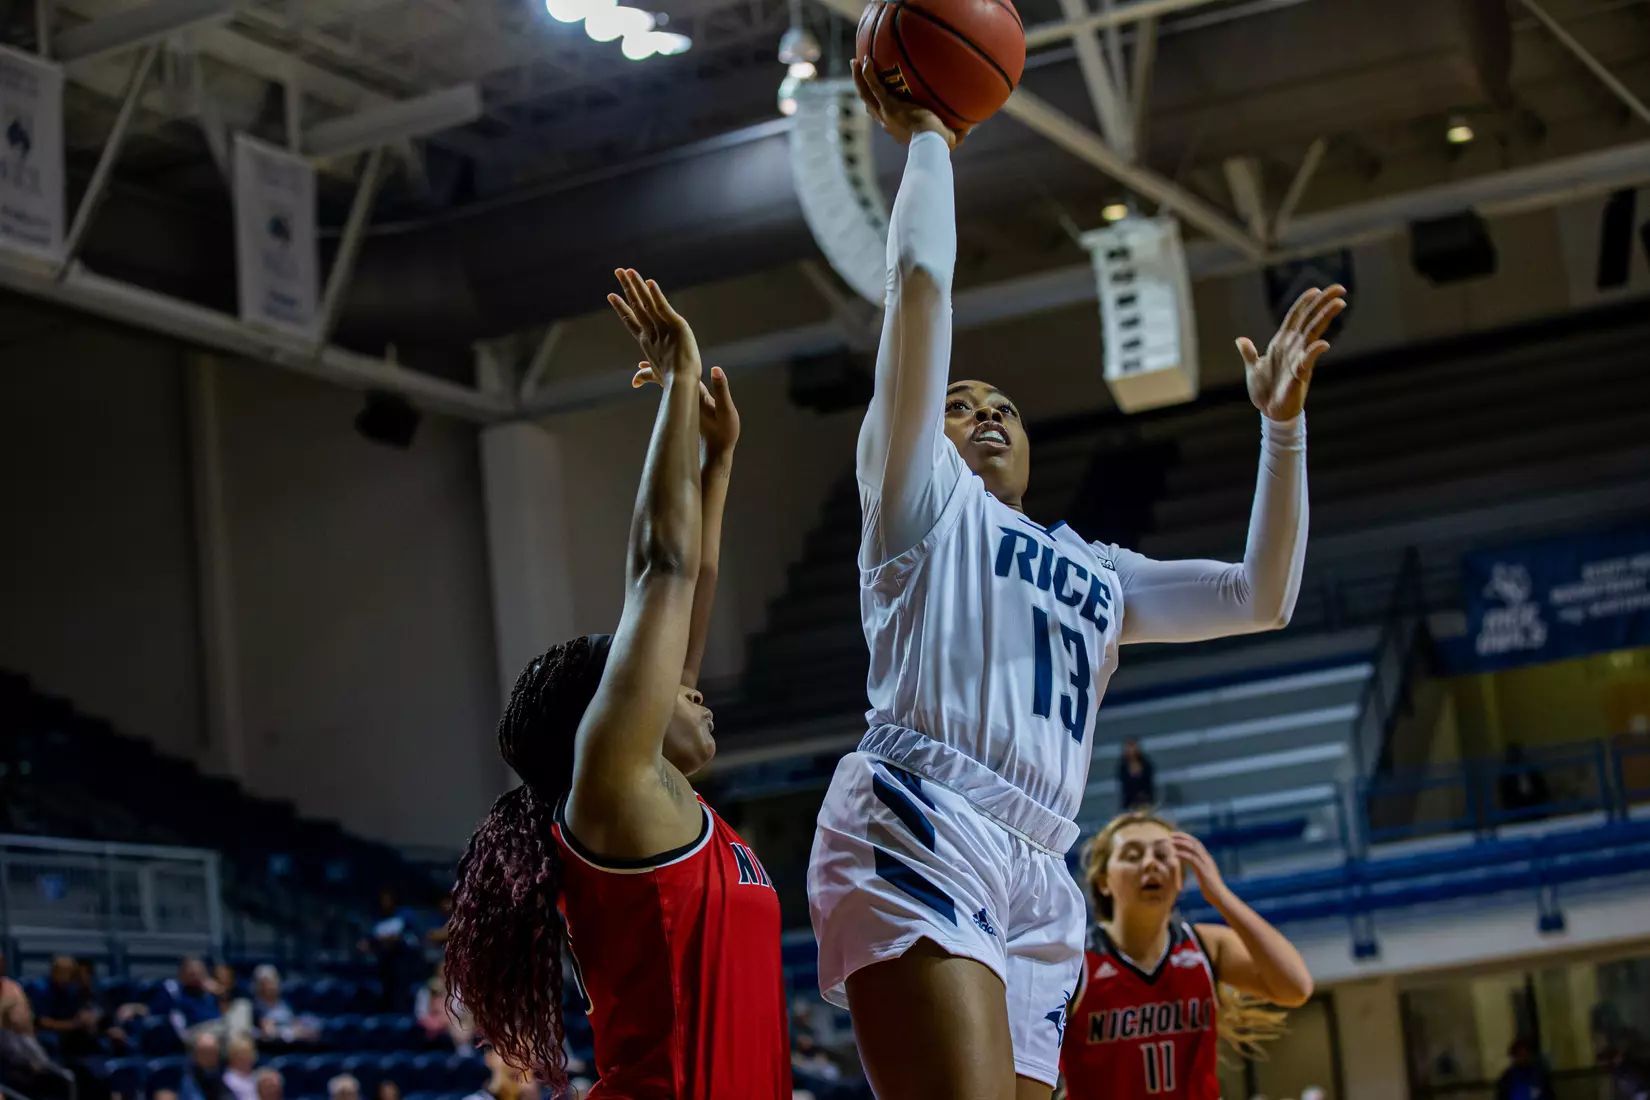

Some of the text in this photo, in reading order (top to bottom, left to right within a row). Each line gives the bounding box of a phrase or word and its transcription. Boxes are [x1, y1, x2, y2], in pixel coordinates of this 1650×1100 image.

[995, 525, 1112, 634] RICE
[1032, 605, 1091, 745] 13
[729, 842, 776, 892] NI
[1139, 1041, 1176, 1094] 11
